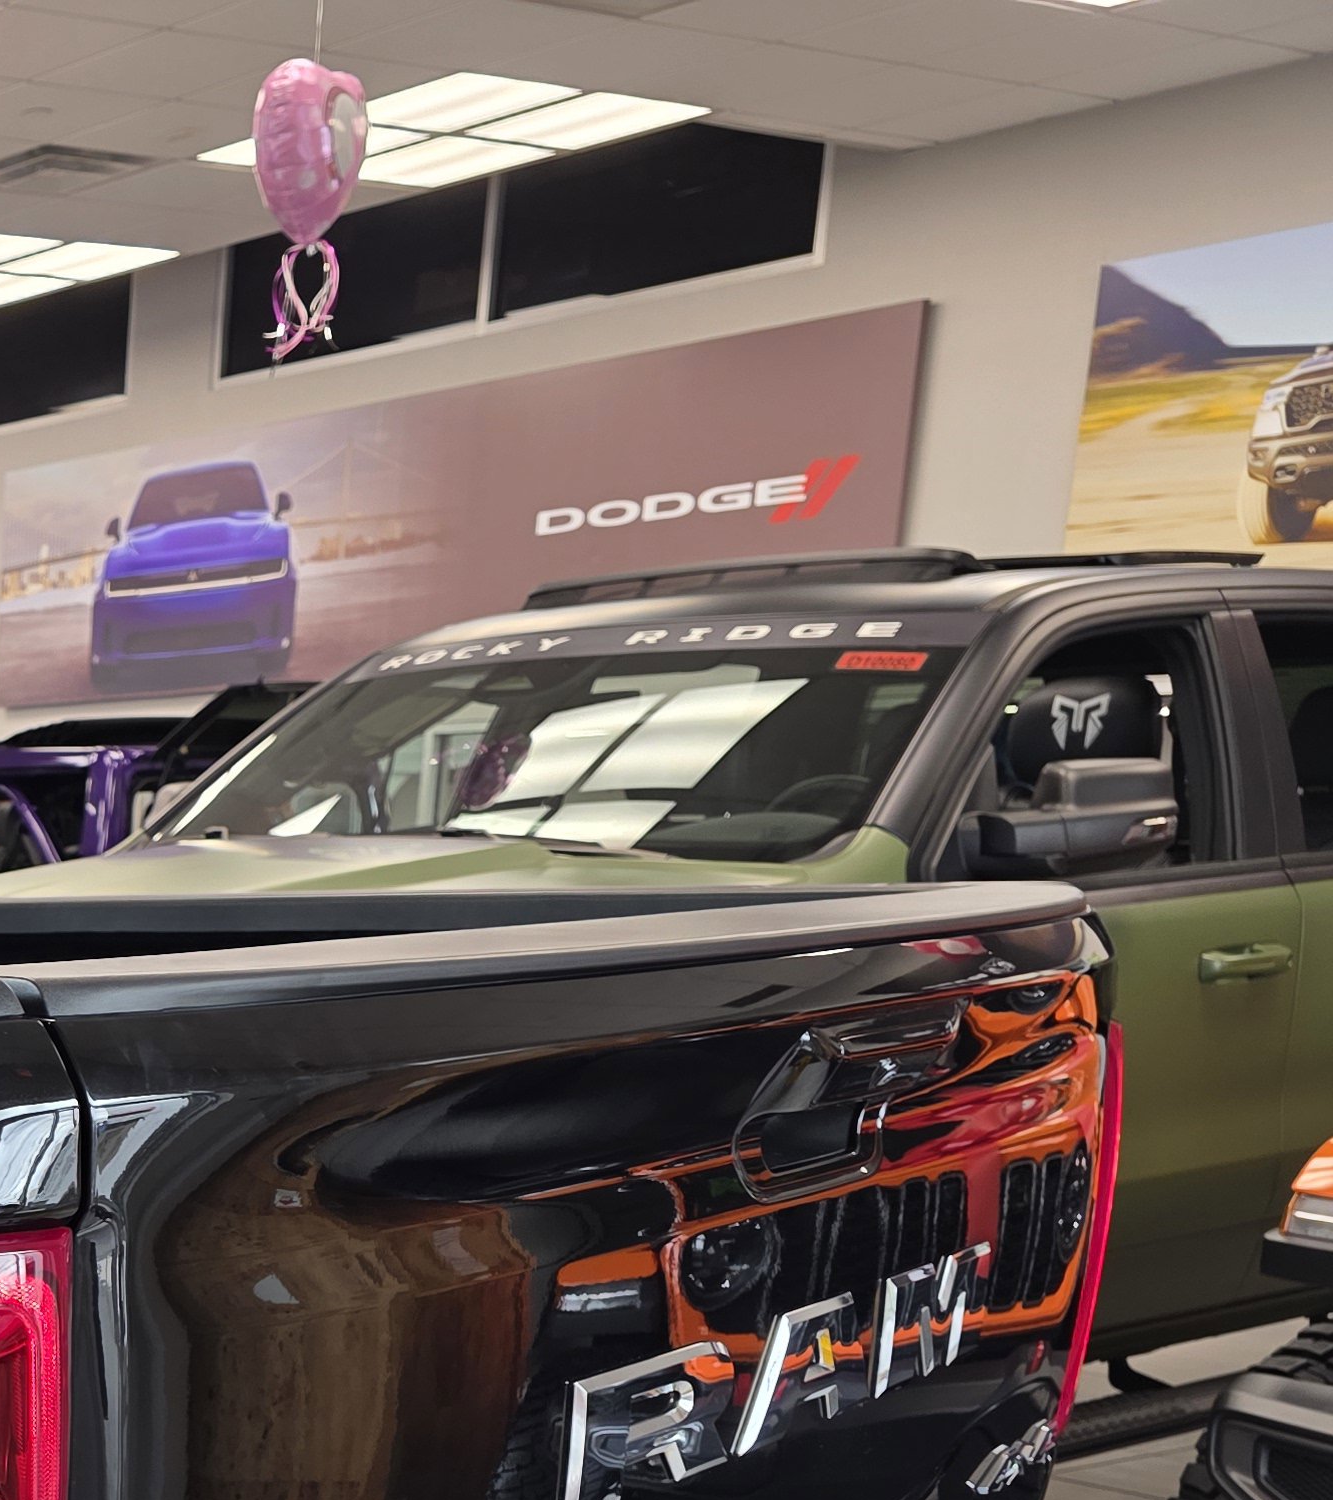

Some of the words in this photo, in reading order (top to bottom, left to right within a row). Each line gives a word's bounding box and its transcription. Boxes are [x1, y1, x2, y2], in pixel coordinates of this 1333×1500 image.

[535, 474, 808, 536] DODGE
[379, 635, 572, 672] ROCKY
[624, 621, 904, 646] RIDGE
